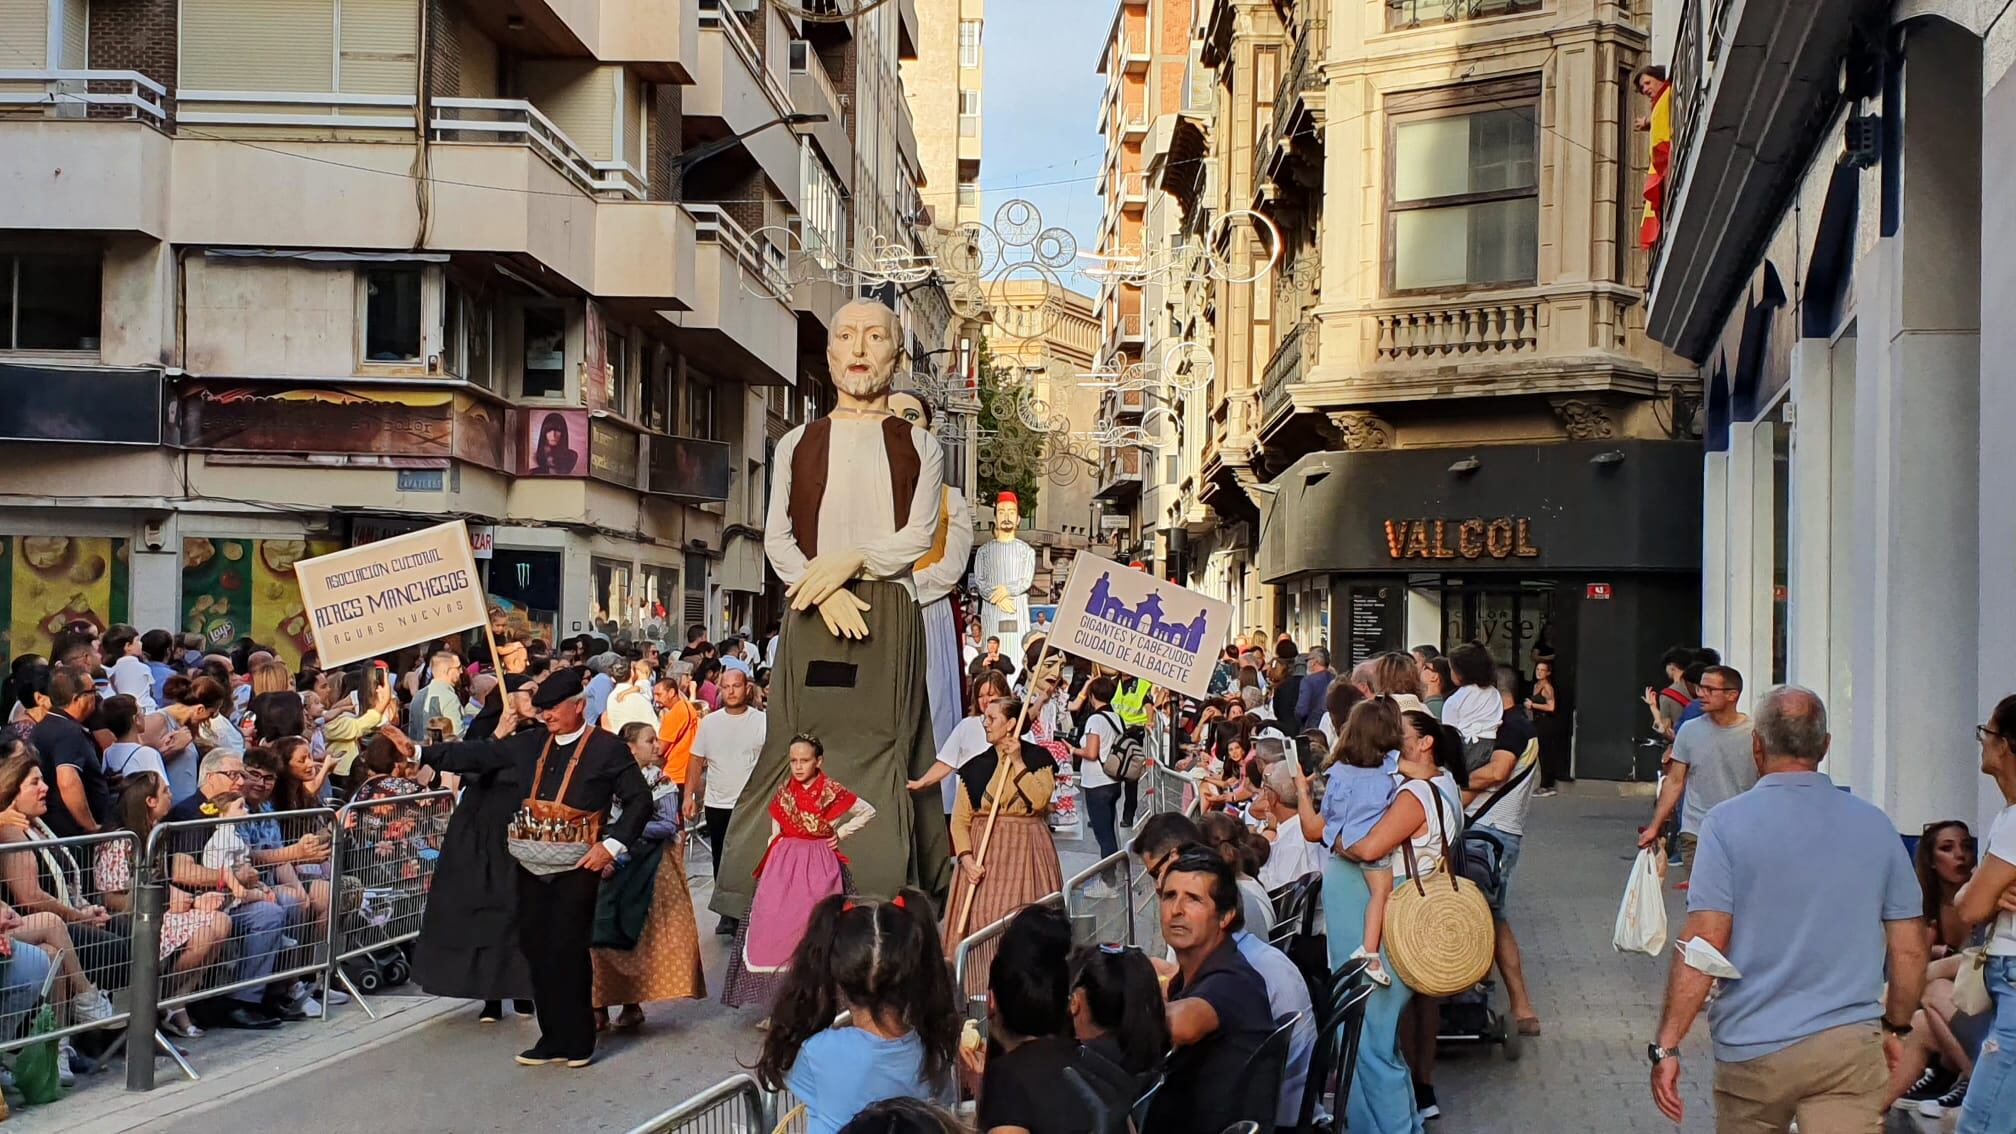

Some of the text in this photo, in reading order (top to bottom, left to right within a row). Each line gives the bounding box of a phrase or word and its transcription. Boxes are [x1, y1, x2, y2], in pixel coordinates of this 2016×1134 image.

[1384, 516, 1538, 558] VALCOL
[315, 569, 469, 628] AIRES MANCHEGOS
[334, 622, 385, 645] AGUAS
[398, 600, 464, 627] NUEVAS
[1074, 630, 1191, 684] CIUDAD DE ALBACETE
[1080, 615, 1196, 667] GIGANTES Y CABEZUDOS
